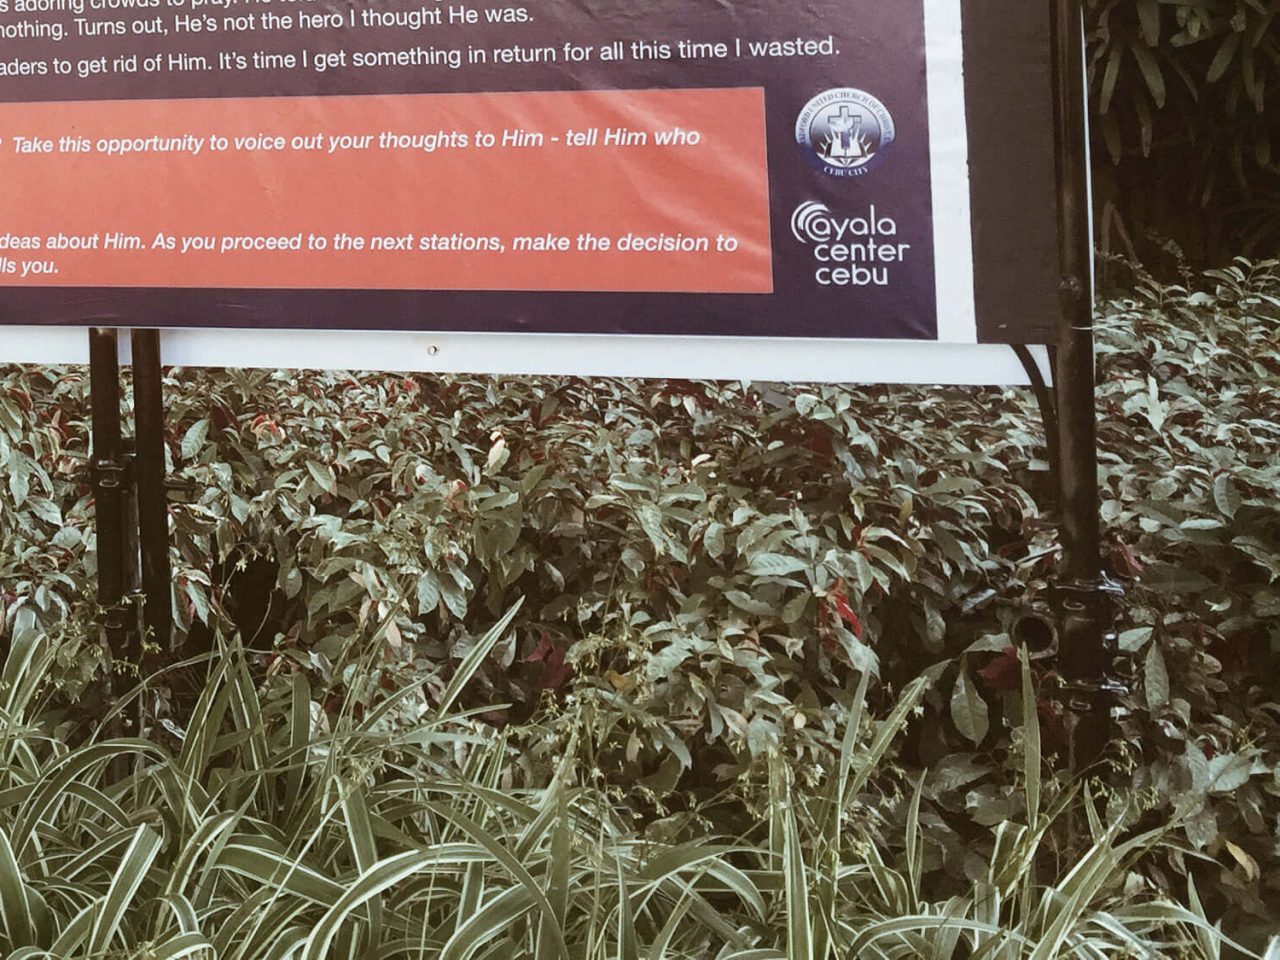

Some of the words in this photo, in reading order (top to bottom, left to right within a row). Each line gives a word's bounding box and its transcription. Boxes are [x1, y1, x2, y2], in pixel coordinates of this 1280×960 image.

[811, 204, 897, 241] ayala
[46, 232, 99, 249] about
[104, 232, 146, 249] Him.
[151, 232, 176, 249] As
[180, 236, 216, 253] you
[220, 233, 302, 253] proceed
[308, 234, 327, 250] to
[333, 233, 364, 250] the
[370, 234, 414, 250] next
[419, 232, 505, 253] stations,
[512, 233, 570, 250] make
[576, 233, 610, 250] the
[617, 233, 708, 251] decision
[716, 234, 738, 252] to
[813, 238, 911, 262] center
[20, 260, 58, 278] you.
[815, 264, 889, 286] cebu
